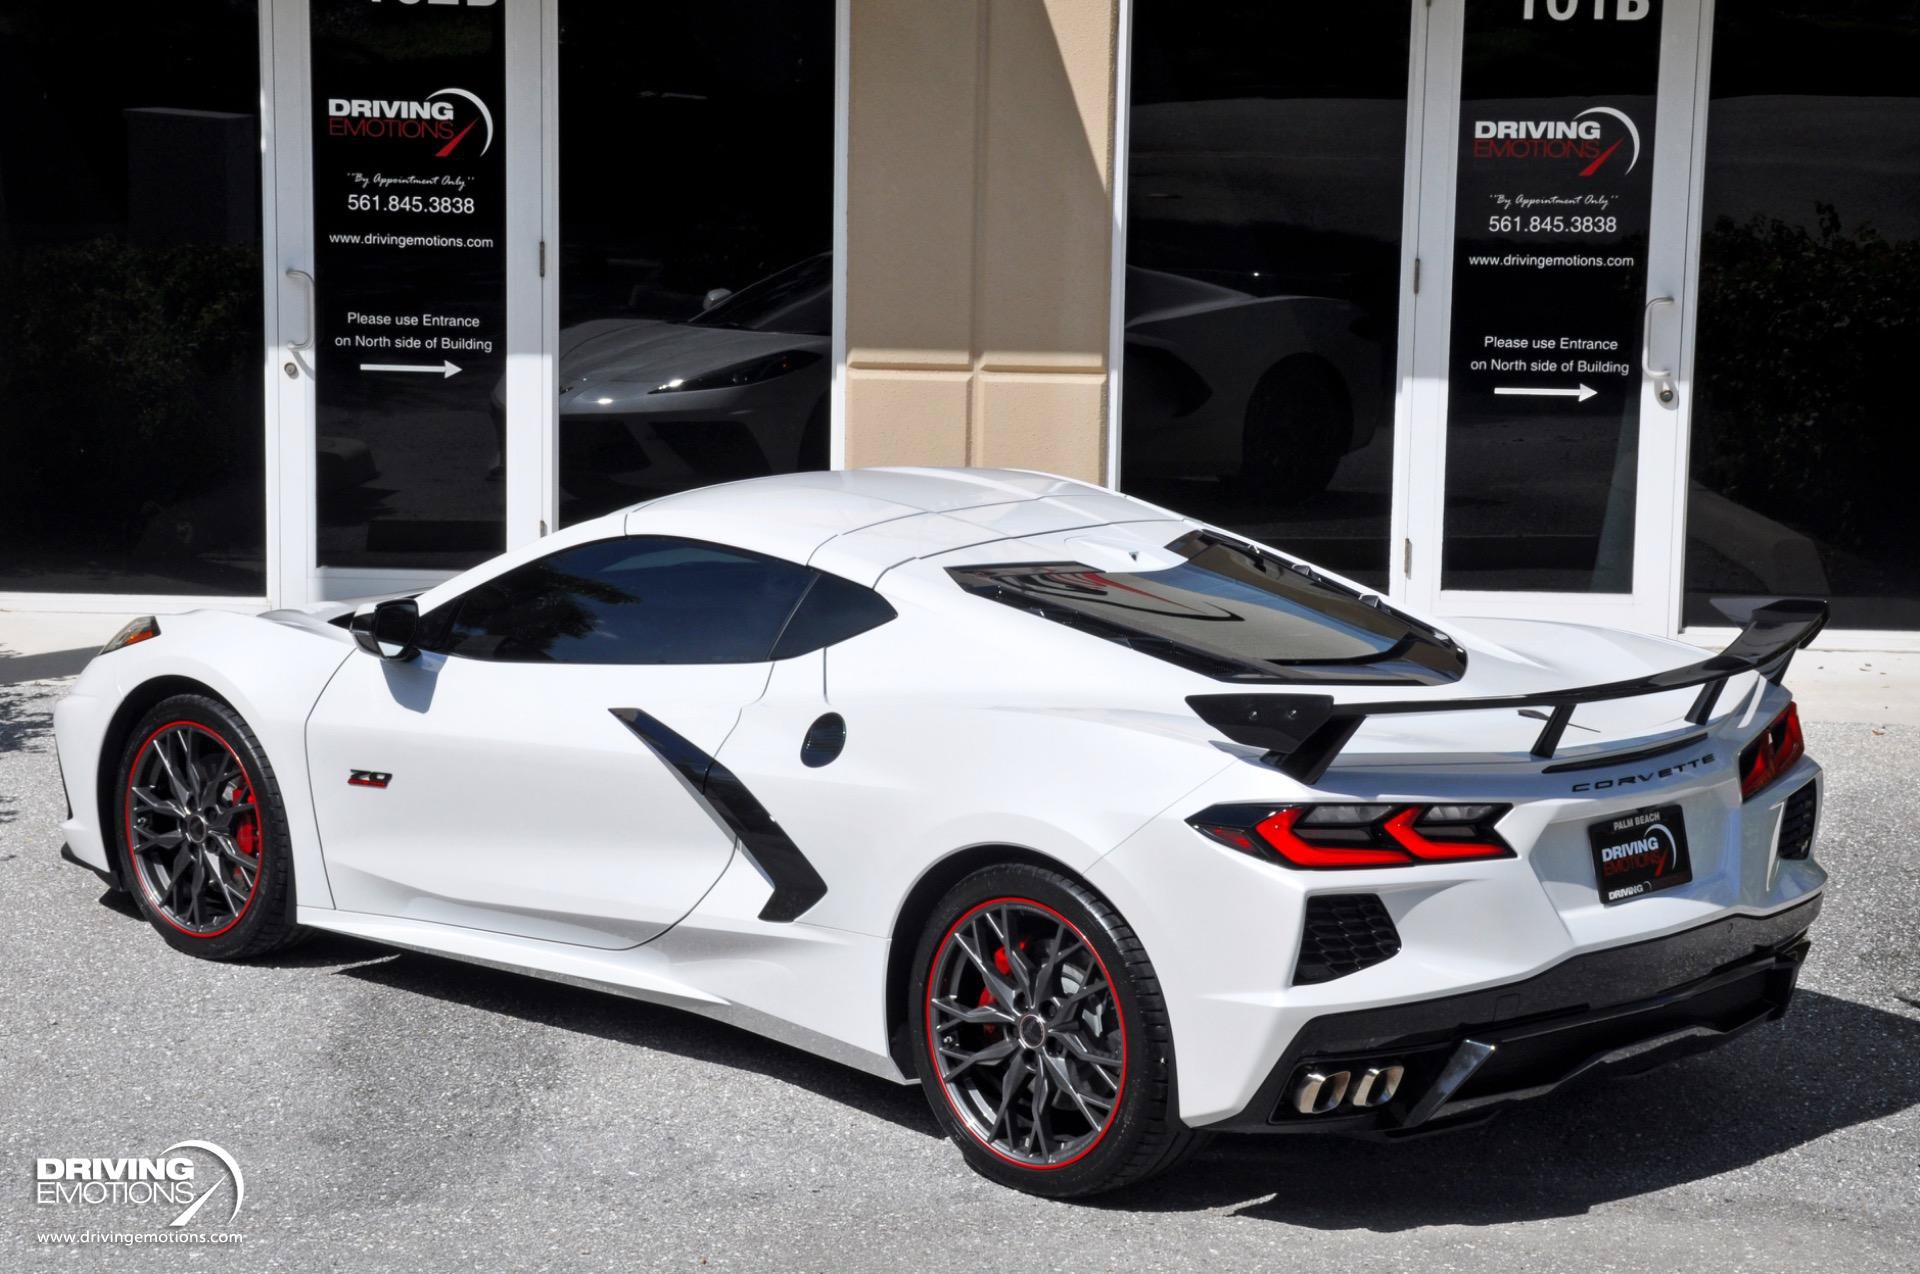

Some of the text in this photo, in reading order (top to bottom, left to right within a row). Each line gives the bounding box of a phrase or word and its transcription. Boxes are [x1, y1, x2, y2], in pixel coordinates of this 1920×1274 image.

[328, 98, 454, 120] DRIVING
[329, 118, 454, 139] EMOTIONS
[1474, 121, 1601, 140] DRIVING
[1473, 139, 1600, 158] EMOTIONS
[373, 173, 439, 187] Appointment
[347, 194, 475, 214] 561.845.3838
[1515, 194, 1582, 208] Appointment
[1488, 216, 1617, 233] 561.845.3838
[329, 233, 494, 248] www.drivingemotions.com
[1469, 254, 1634, 269] www.drivingemotions.com
[347, 311, 480, 327] Please use Entrance
[334, 335, 493, 353] on North side of Building
[1484, 335, 1618, 350] Please use Entrance
[1470, 359, 1630, 376] on North side of Building
[1571, 753, 1715, 792] CORVETTE
[1613, 811, 1661, 831] PALM BEACH
[1602, 836, 1659, 863] DRIVING
[1608, 884, 1644, 900] DRIVING
